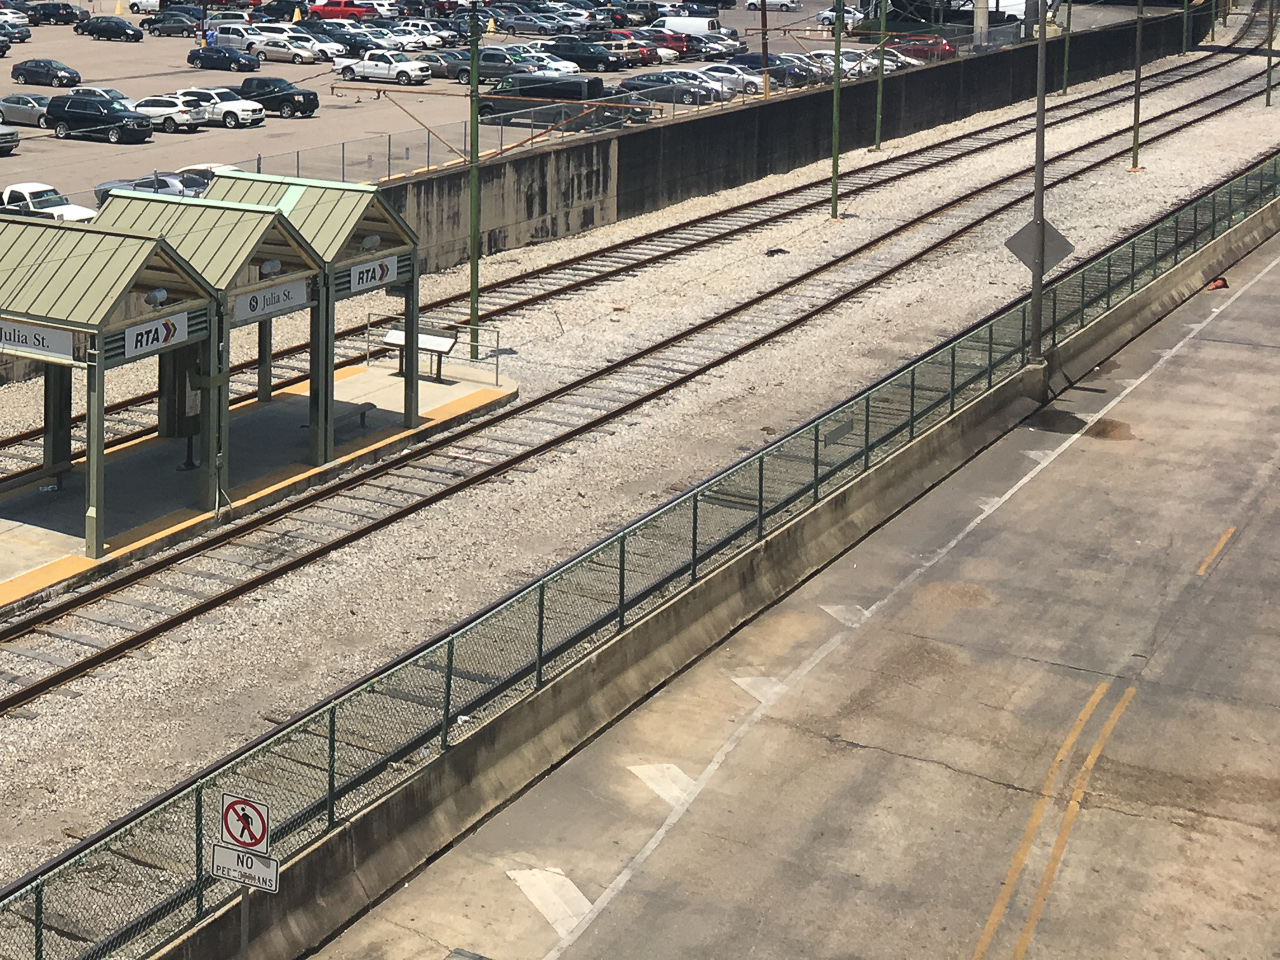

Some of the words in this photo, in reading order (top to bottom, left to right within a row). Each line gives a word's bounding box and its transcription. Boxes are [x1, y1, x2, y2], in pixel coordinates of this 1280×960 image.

[357, 267, 377, 286] RTA
[261, 292, 281, 311] Julia
[283, 289, 293, 302] St.
[33, 333, 50, 349] St.
[134, 327, 160, 350] RTA
[236, 853, 253, 870] NO
